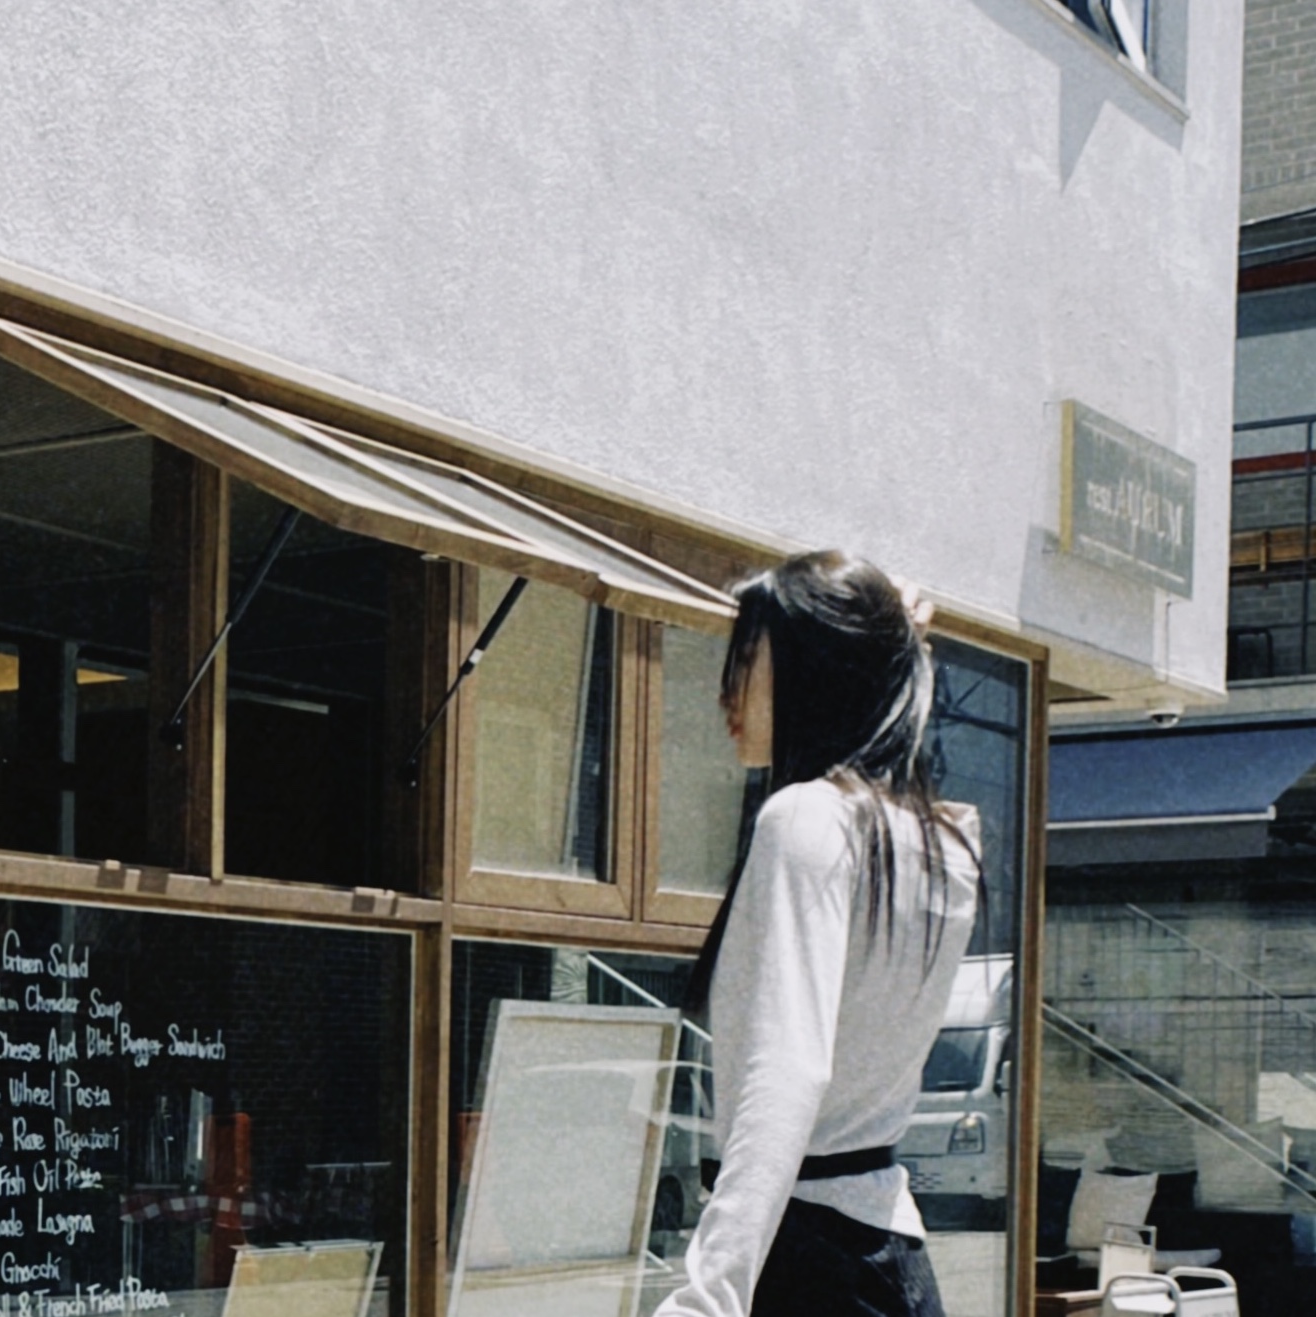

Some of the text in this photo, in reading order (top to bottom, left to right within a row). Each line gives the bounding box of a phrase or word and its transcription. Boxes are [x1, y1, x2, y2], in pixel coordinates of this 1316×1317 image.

[1, 928, 44, 974] Green
[47, 943, 90, 979] Salad
[88, 987, 123, 1035] Soup
[47, 1027, 79, 1065] And
[167, 1022, 227, 1061] Sandwich
[9, 1069, 57, 1110] Wheel
[62, 1067, 112, 1116] Pasta
[53, 1116, 121, 1160] Rigatoni
[33, 1157, 61, 1193] Oil
[36, 1196, 96, 1246] Lasagna
[0, 1250, 63, 1285] Gnocchi
[86, 1278, 126, 1313] Fried
[125, 1274, 171, 1313] Pasta
